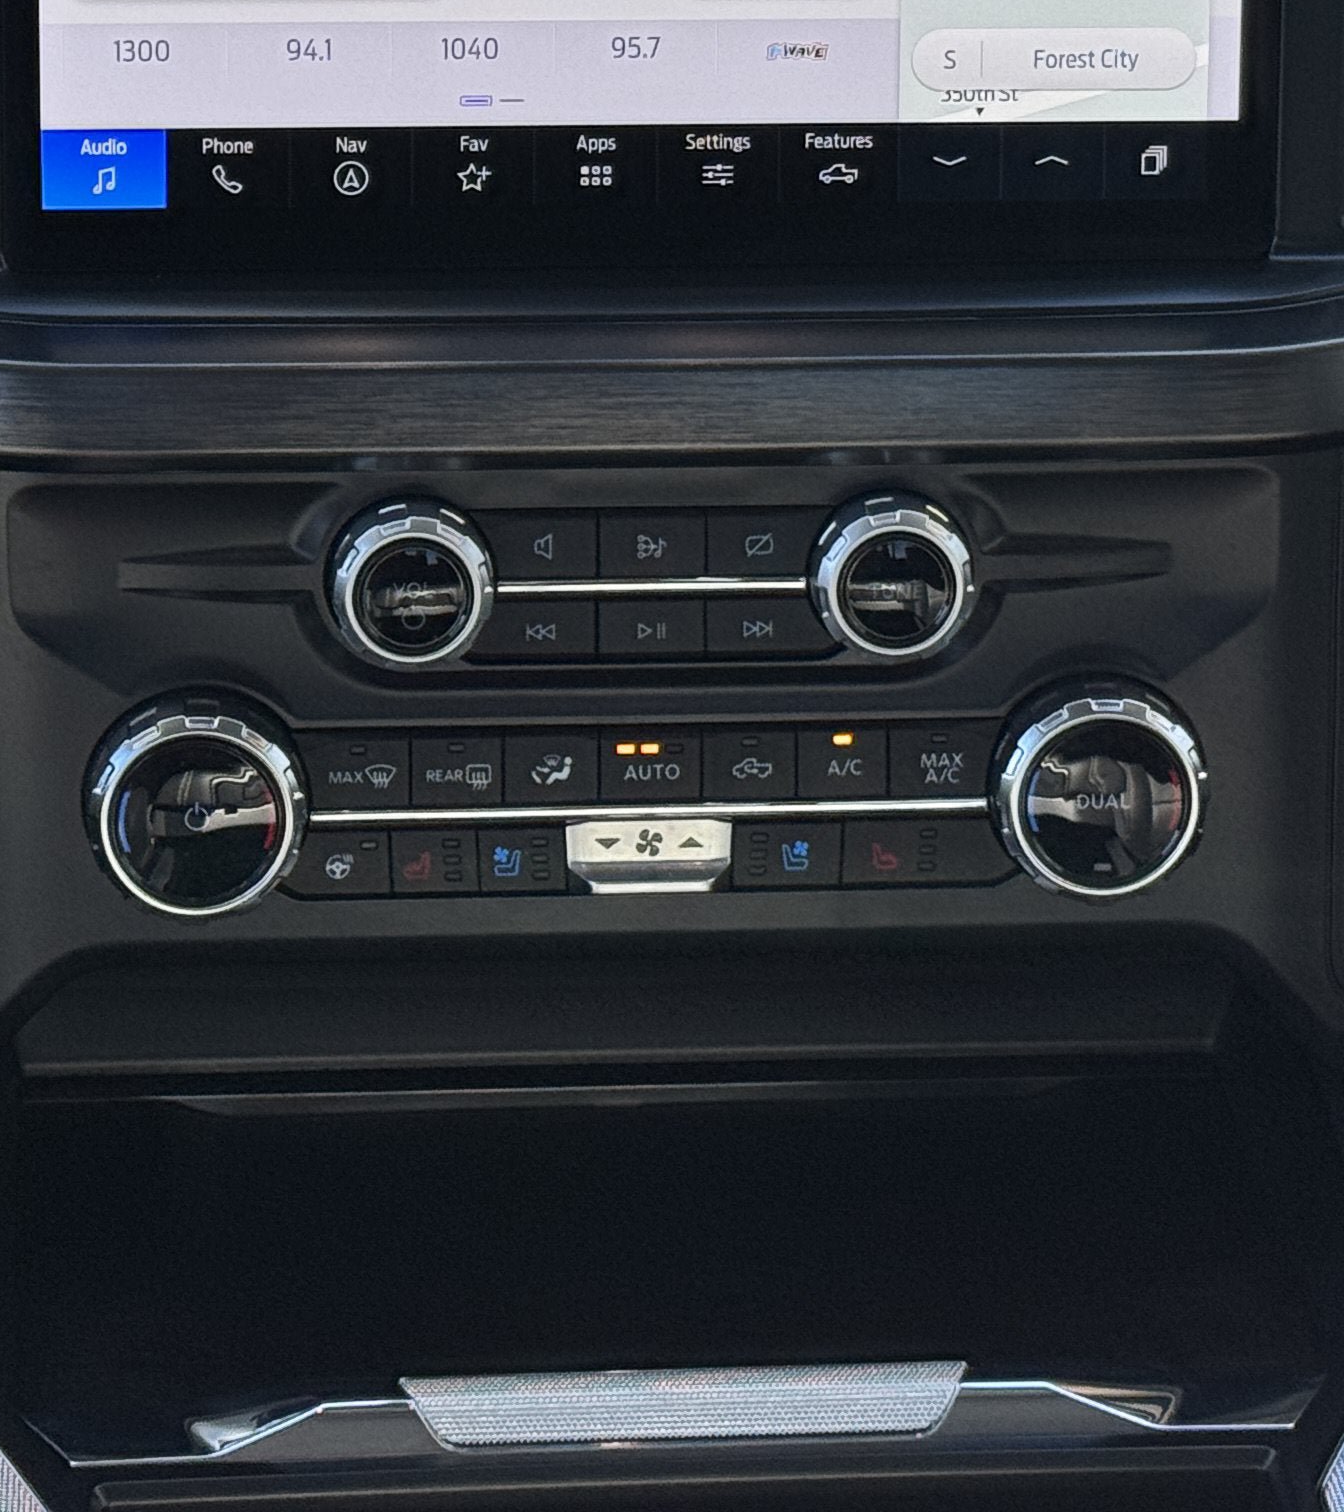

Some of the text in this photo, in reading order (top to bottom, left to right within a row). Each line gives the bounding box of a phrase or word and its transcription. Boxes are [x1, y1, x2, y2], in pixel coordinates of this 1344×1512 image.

[113, 39, 171, 62] 1300
[285, 38, 333, 61] 94.1
[440, 37, 499, 60] 1040
[610, 36, 661, 59] 95.7
[943, 49, 956, 71] S
[1032, 47, 1140, 74] Forest City
[80, 138, 127, 157] Audio
[201, 136, 254, 156] Phone
[335, 137, 367, 155] Nav
[460, 135, 489, 153] Fav
[576, 134, 616, 156] Apps
[685, 133, 751, 154] Settings
[804, 132, 874, 150] Features
[827, 759, 863, 777] A/C
[920, 753, 964, 769] MAX
[328, 769, 364, 785] MAX
[426, 768, 464, 784] REAR
[624, 764, 682, 781] AUTO
[924, 767, 961, 785] A/C
[1076, 793, 1131, 810] DUAL
